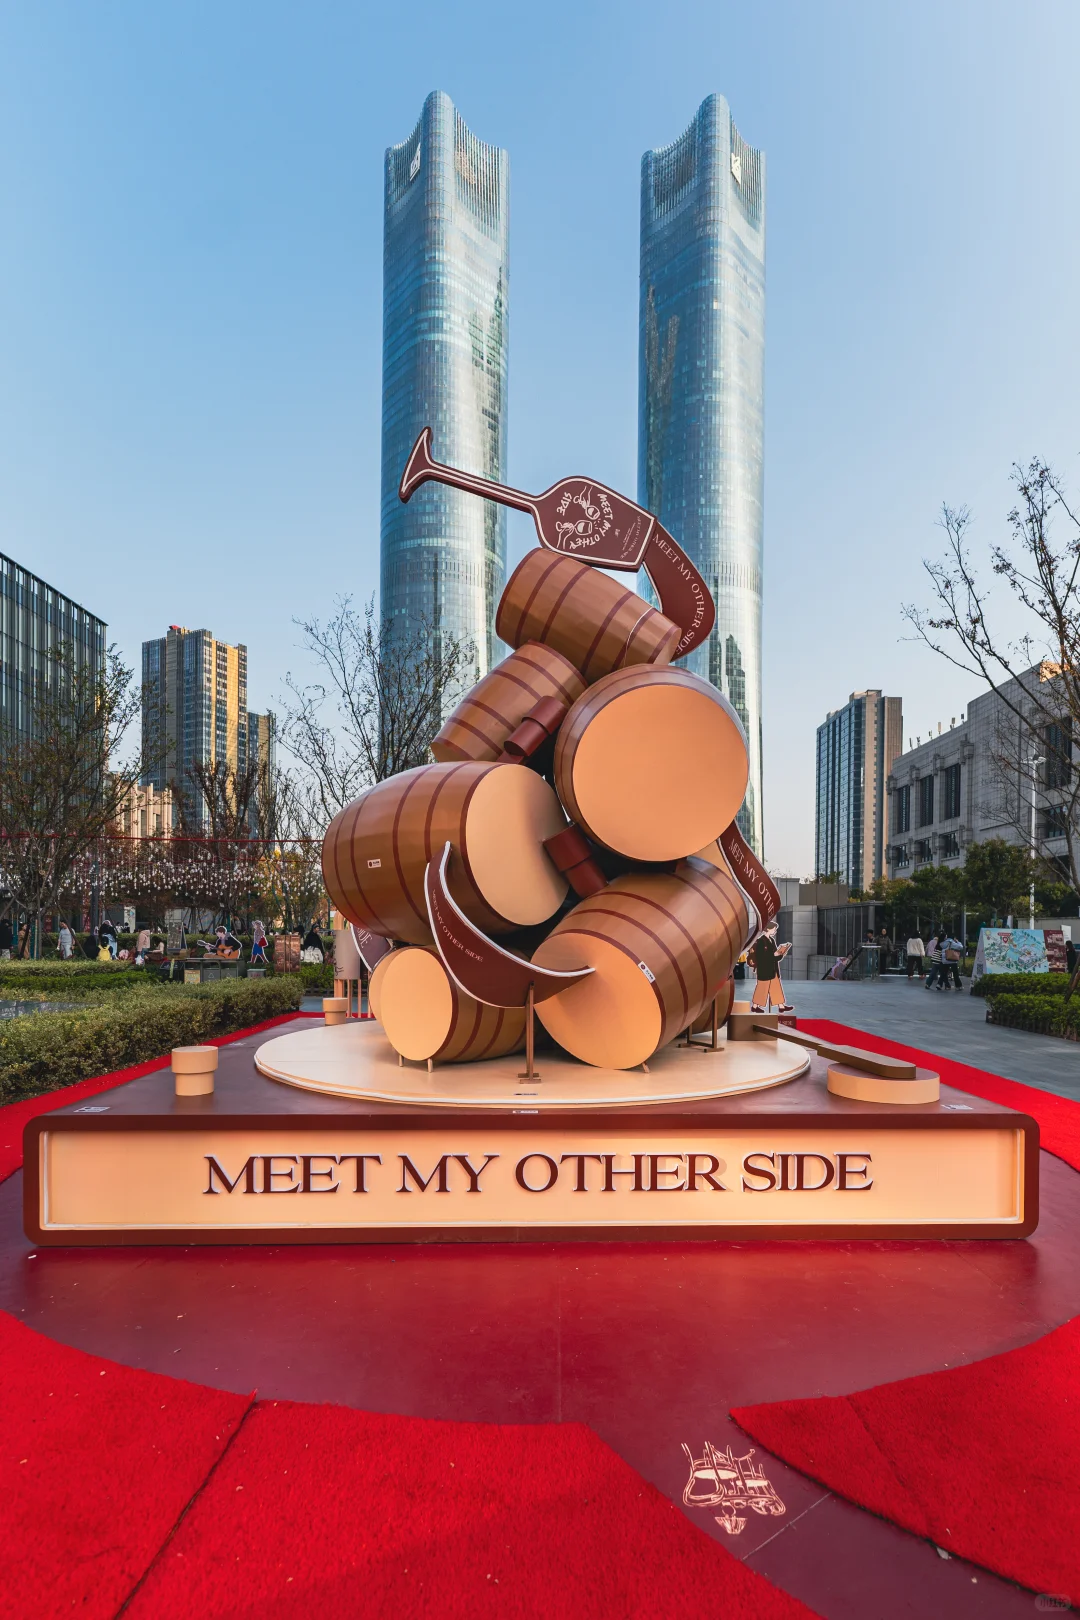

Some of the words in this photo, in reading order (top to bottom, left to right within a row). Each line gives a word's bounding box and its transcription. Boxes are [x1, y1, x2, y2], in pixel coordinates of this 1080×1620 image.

[556, 491, 573, 517] SIDE
[597, 493, 614, 520] MEET
[598, 519, 612, 537] MY
[569, 534, 601, 550] OTHER
[652, 533, 681, 563] MEET
[677, 562, 695, 581] MY
[691, 583, 705, 628] OTHER
[676, 629, 695, 655] SIDE
[728, 838, 745, 865] MEET
[743, 861, 759, 882] MY
[442, 925, 464, 951] OTHER
[464, 948, 484, 963] SIDE
[202, 1153, 383, 1194] MEET
[396, 1152, 500, 1193] MY
[514, 1151, 727, 1193] OTHER
[740, 1150, 874, 1193] SIDE
